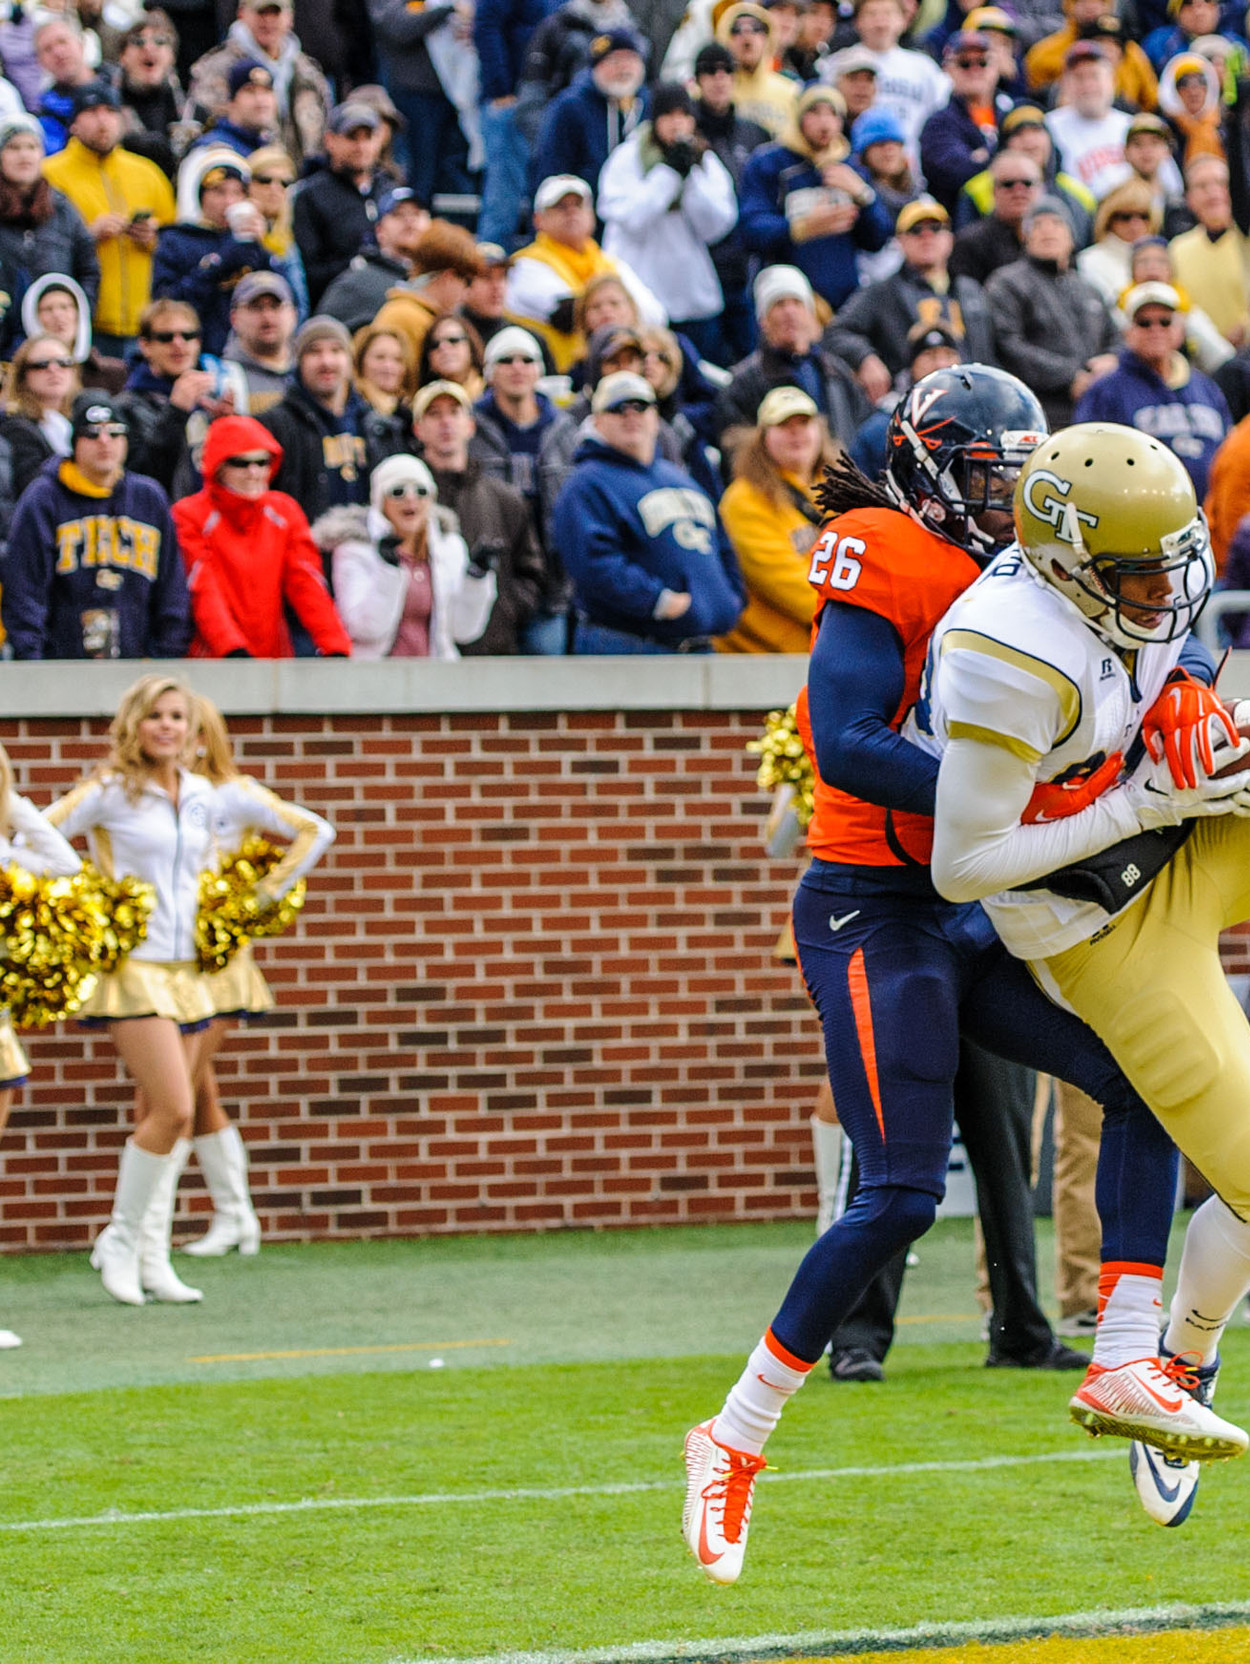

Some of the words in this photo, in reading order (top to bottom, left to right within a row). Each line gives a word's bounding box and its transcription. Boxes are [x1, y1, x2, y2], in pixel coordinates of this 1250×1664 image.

[1022, 468, 1100, 544] GT
[807, 530, 867, 591] 26
[1121, 863, 1141, 887] 88
